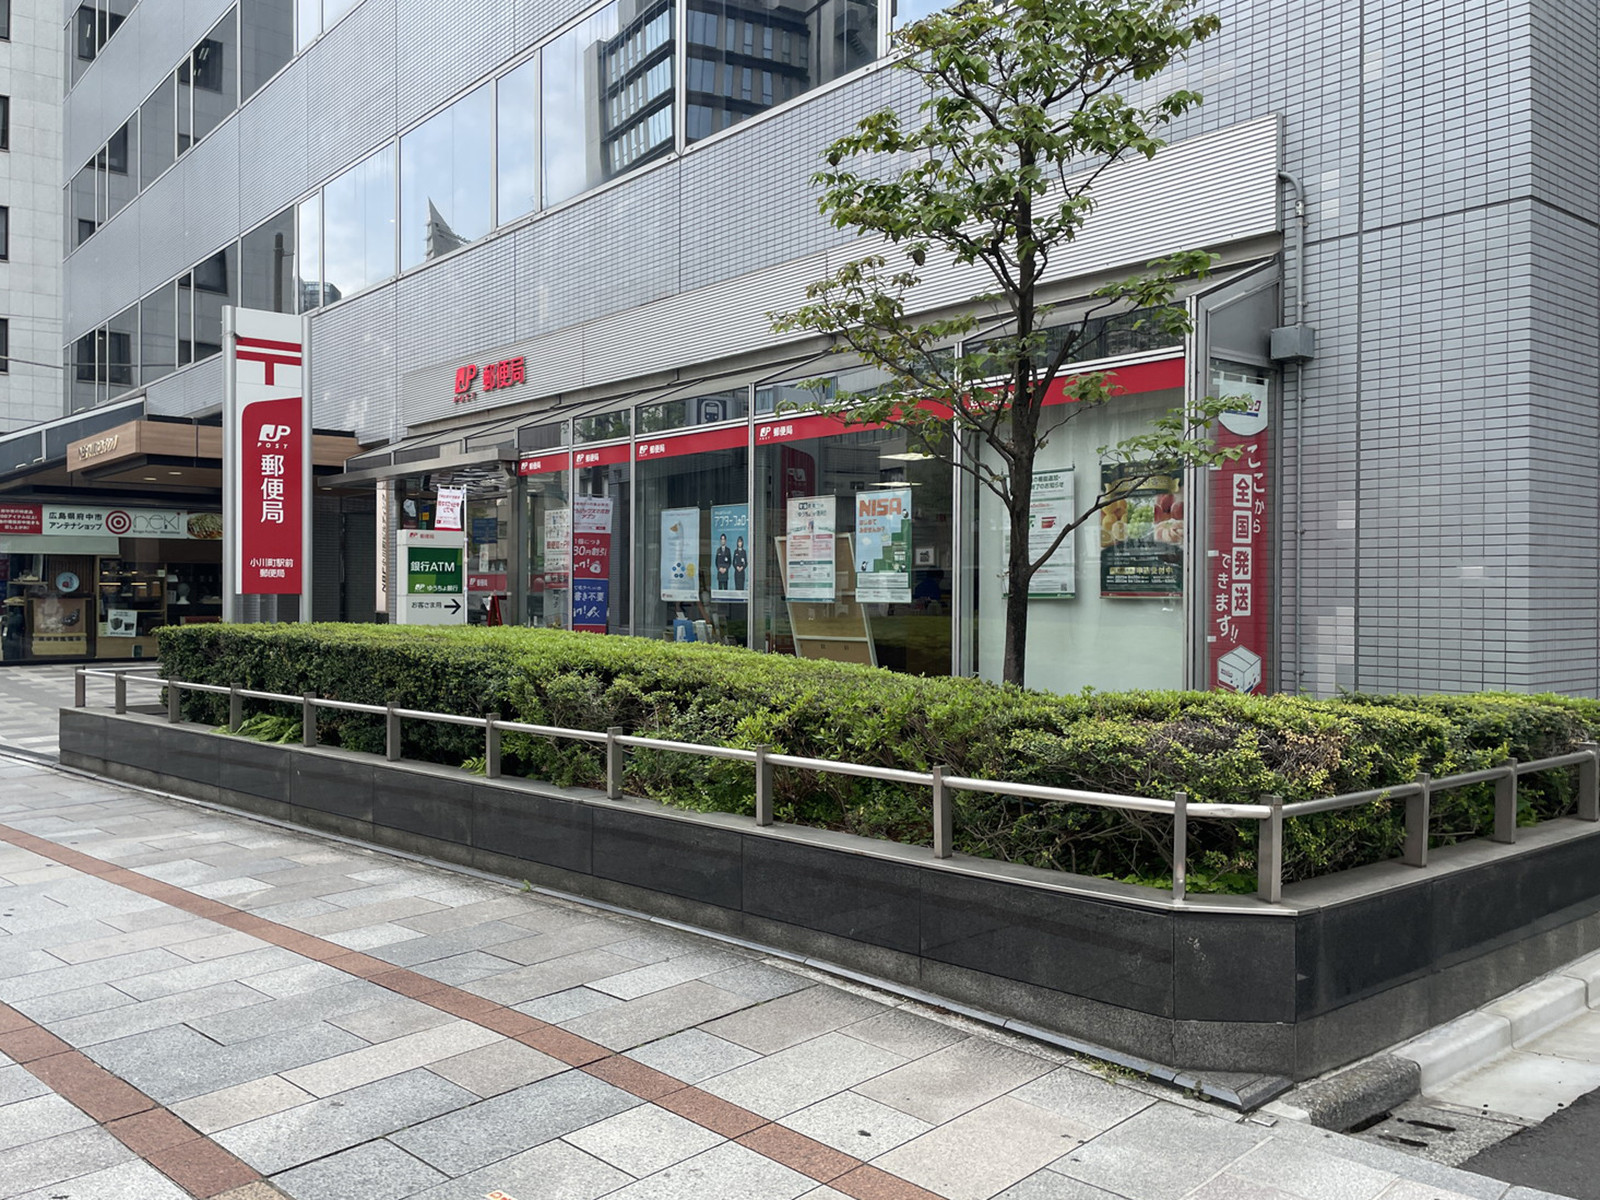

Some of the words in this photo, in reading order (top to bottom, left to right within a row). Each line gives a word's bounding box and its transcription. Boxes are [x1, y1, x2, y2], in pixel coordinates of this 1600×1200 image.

[483, 356, 525, 391] 郵便局
[259, 424, 291, 442] JP
[773, 424, 793, 437] 郵便局
[649, 444, 665, 455] 郵便局
[261, 454, 284, 524] 郵便局
[1247, 444, 1266, 533] ここから
[859, 498, 902, 517] NISA
[49, 511, 102, 521] 広島県府中市
[49, 521, 103, 531] アンテナショップ
[1233, 475, 1252, 615] 全国発送
[250, 558, 294, 568] 小川町駅前
[410, 561, 455, 572] 銀行ATM
[259, 568, 289, 578] 郵便局
[427, 584, 459, 592] ゆうちょ銀行
[411, 601, 442, 609] お客さま用
